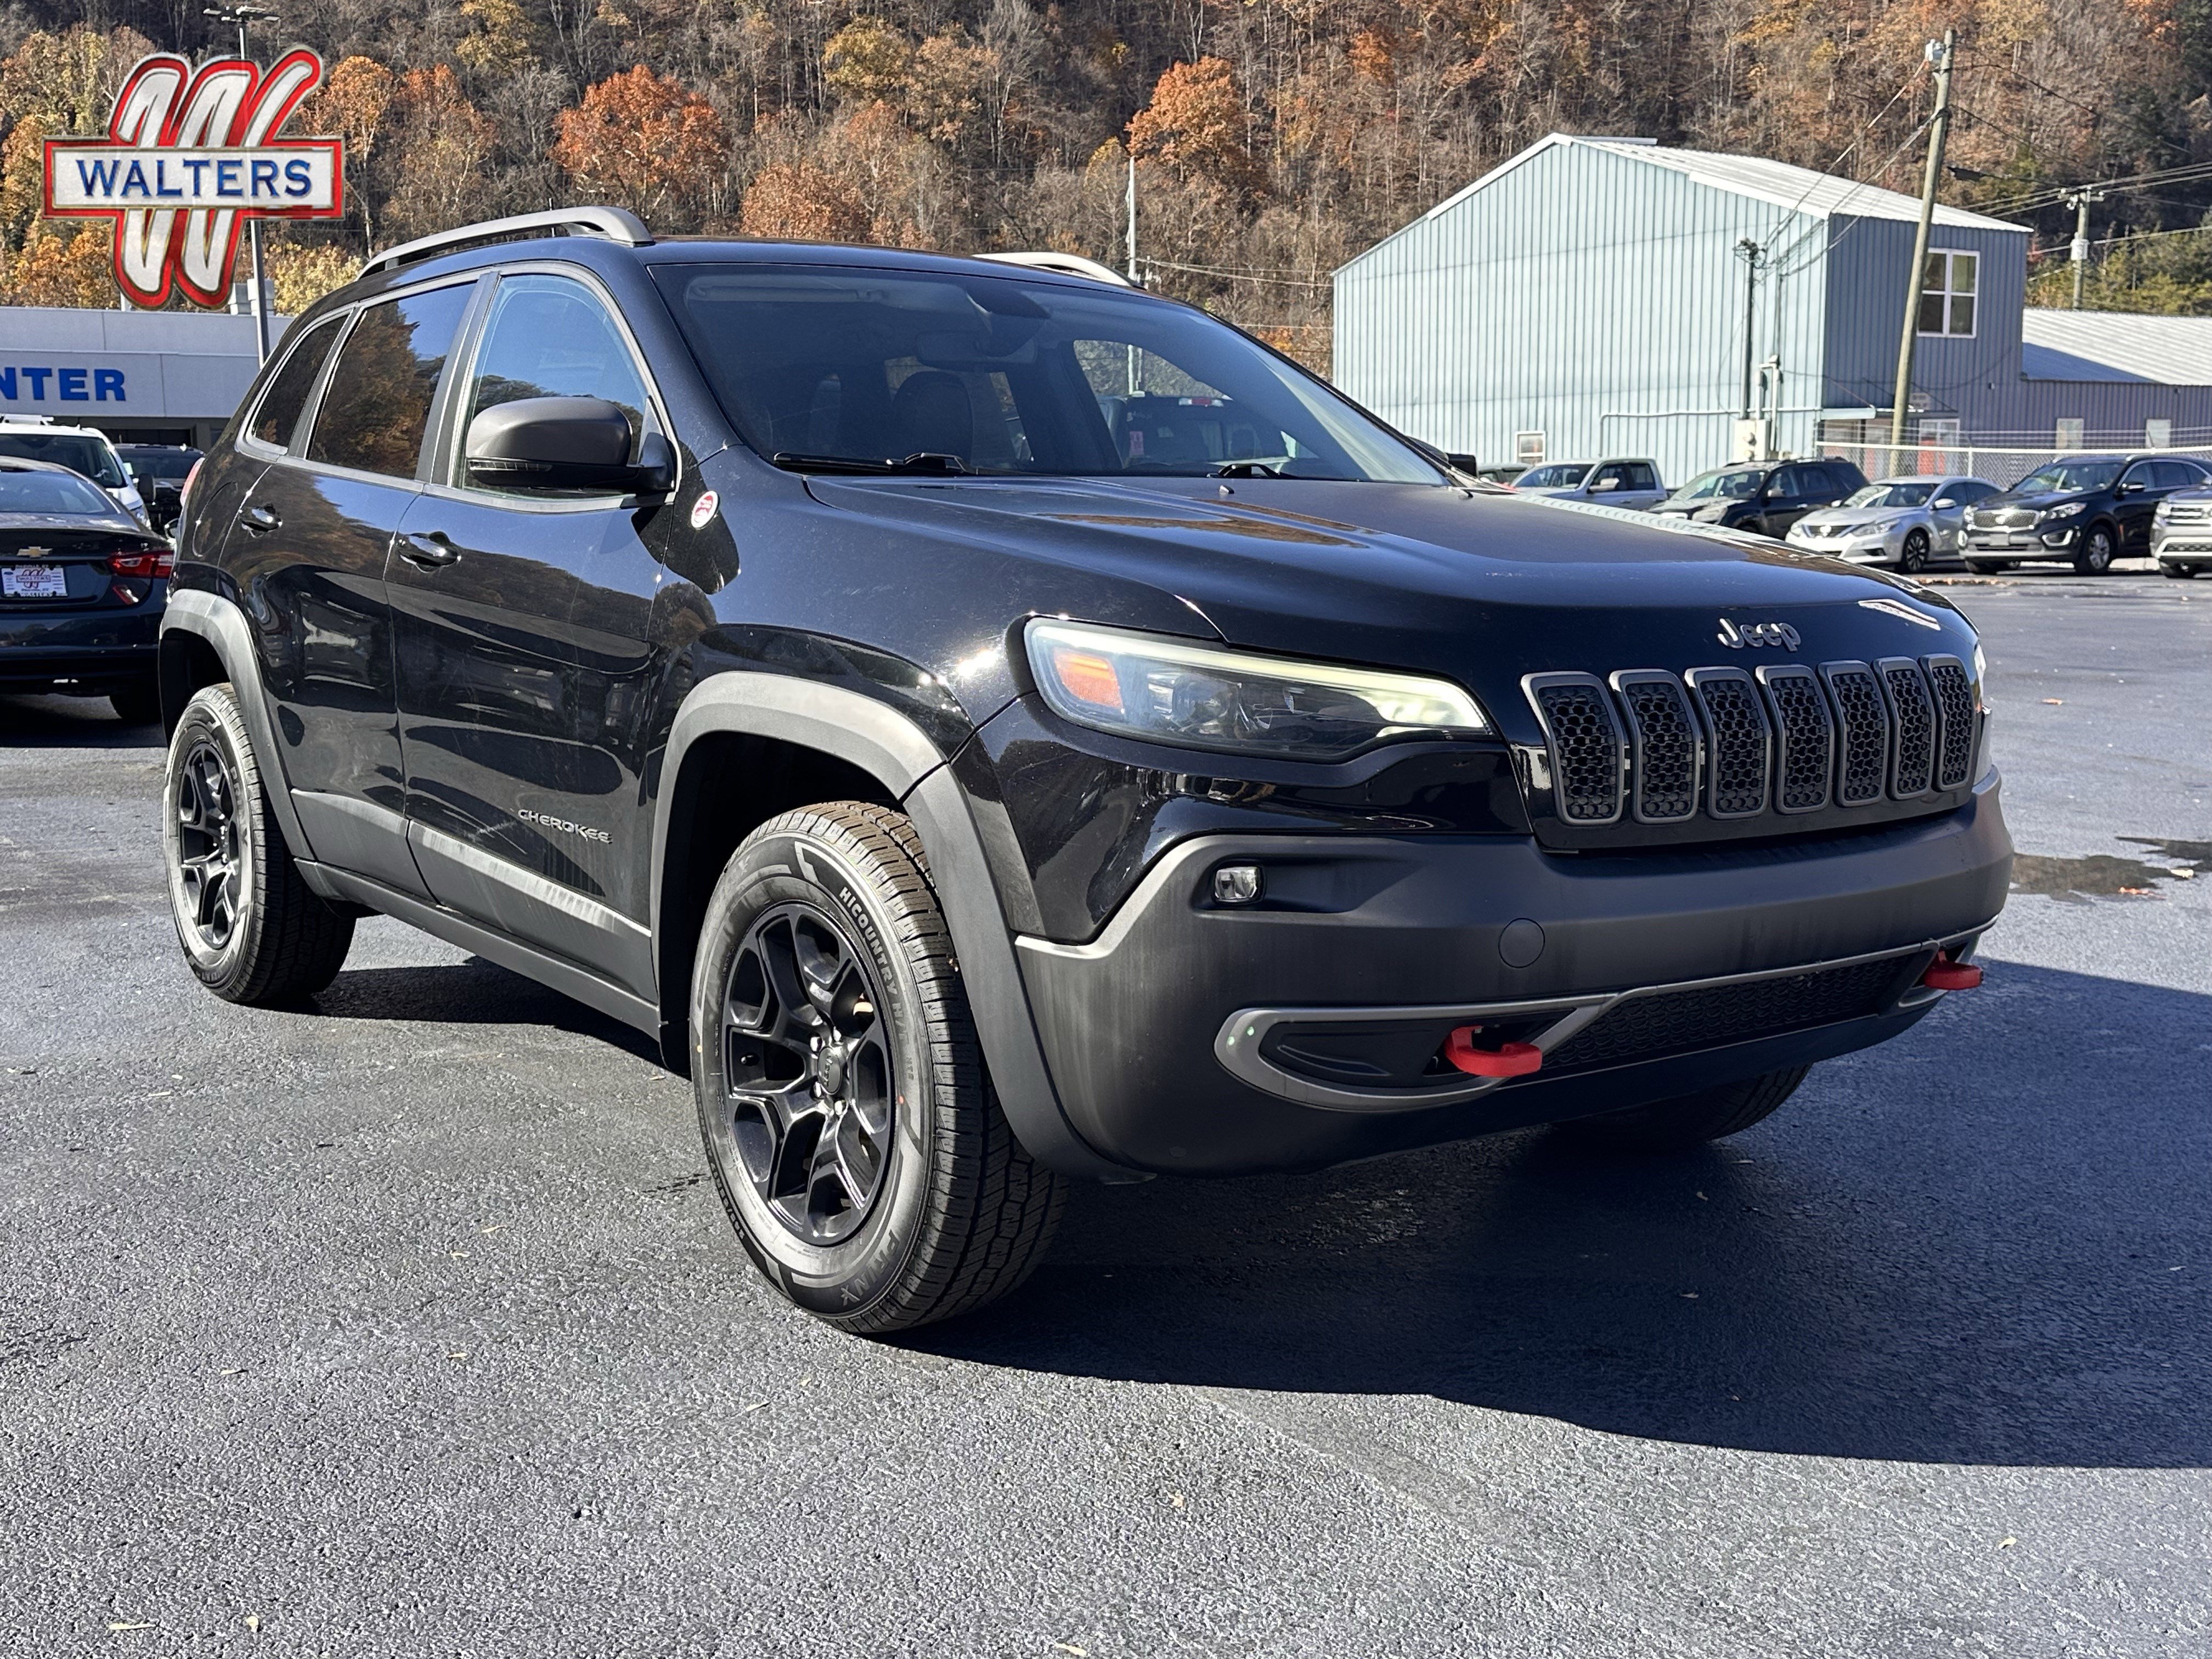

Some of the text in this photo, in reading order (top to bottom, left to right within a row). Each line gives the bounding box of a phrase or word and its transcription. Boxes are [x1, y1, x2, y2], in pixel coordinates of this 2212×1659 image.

[1717, 618, 1801, 652] Jeep
[518, 809, 613, 844] CHEROKEE
[840, 1228, 901, 1307] PRINX
